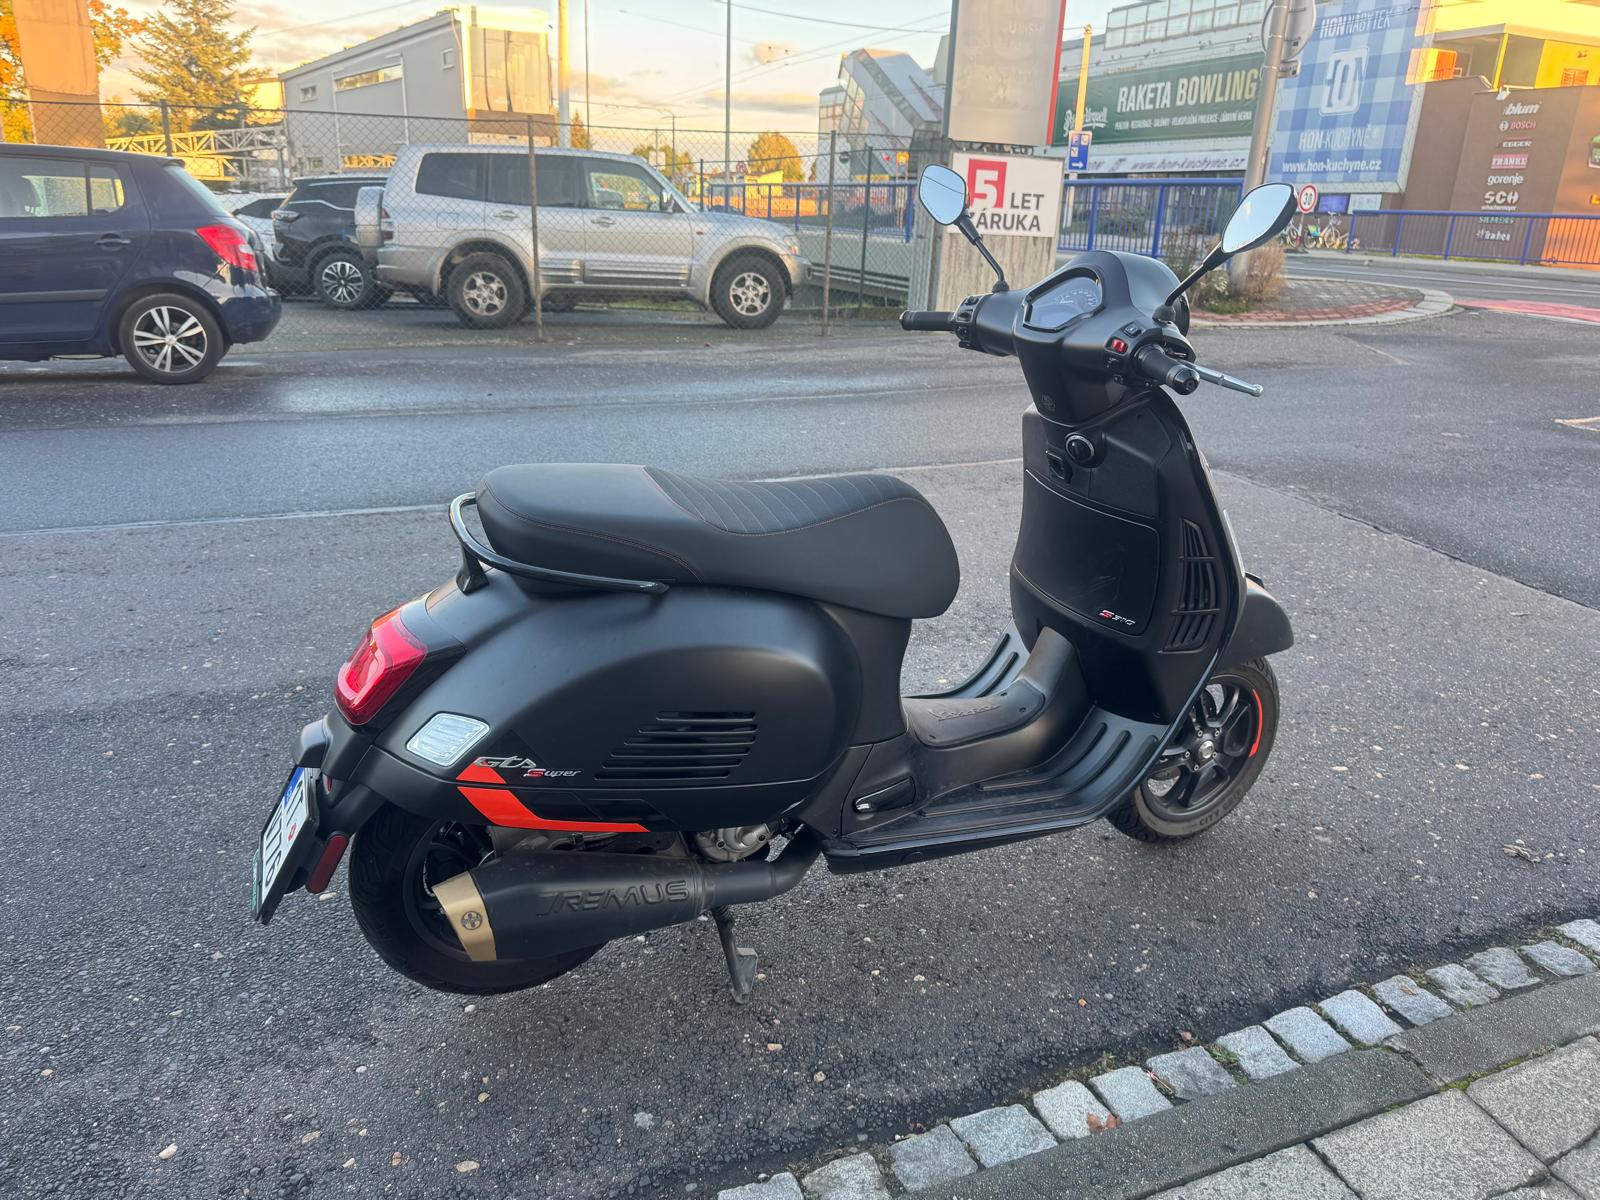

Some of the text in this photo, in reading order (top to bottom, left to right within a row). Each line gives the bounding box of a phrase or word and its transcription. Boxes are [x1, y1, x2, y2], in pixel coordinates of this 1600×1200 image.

[1116, 68, 1259, 113] RAKETA BOWLING
[1505, 102, 1540, 116] blum
[1510, 120, 1537, 129] BOSCH
[1282, 158, 1383, 174] www.hon-kuchyne.cz
[1492, 156, 1528, 167] FRANKE
[1487, 173, 1524, 186] gorenje
[972, 169, 1044, 211] 5 LET
[1484, 191, 1519, 204] SCH
[523, 768, 581, 778] Super
[1199, 809, 1220, 826] CITY
[542, 879, 690, 916] REMUS
